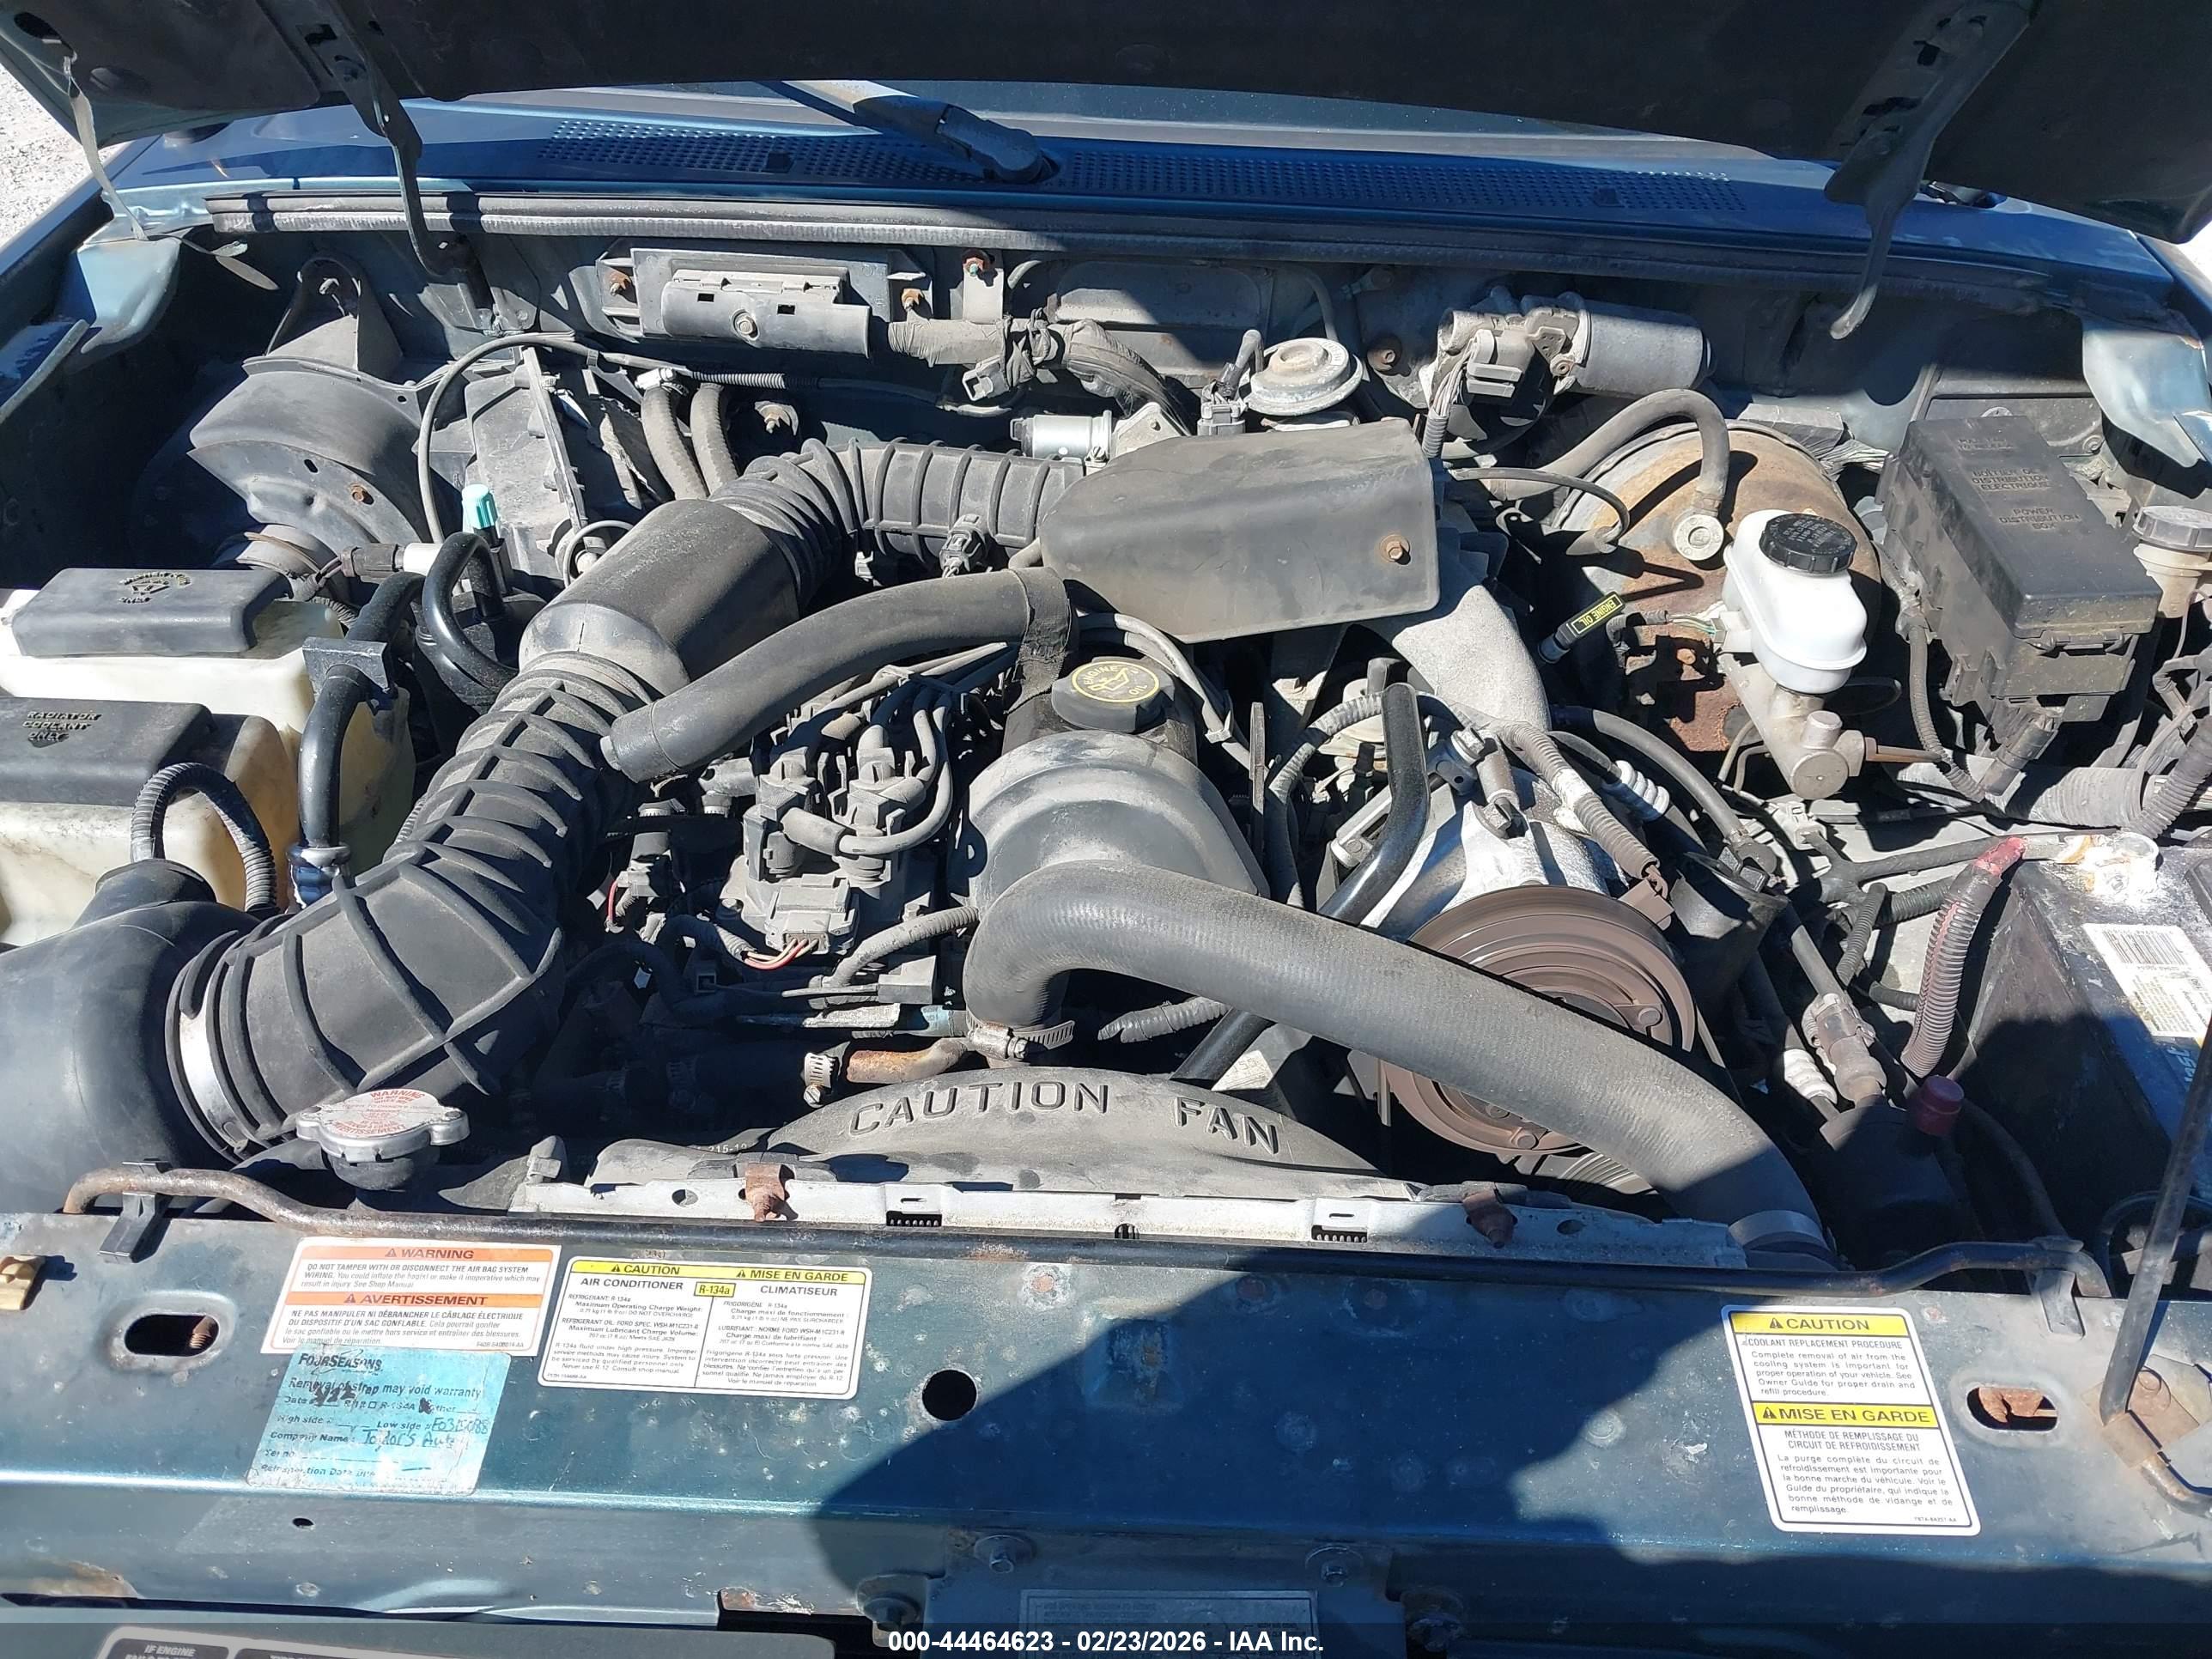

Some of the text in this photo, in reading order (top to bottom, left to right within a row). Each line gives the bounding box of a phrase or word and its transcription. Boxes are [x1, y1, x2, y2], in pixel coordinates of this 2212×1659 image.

[1972, 475, 2049, 484] DISTRIBUTION
[1998, 514, 2081, 523] DISTRIBUTION
[1578, 599, 1616, 627] ENGINE OIL
[1082, 665, 1121, 686] ENGINE
[1128, 684, 1149, 696] OIL
[27, 711, 102, 721] RADIATOR
[21, 720, 93, 731] COOLANT
[27, 731, 70, 741] ONLY
[370, 1090, 426, 1102] WARNING
[848, 1079, 1279, 1155] CAUTION FAN
[399, 1249, 475, 1259] WARNING
[623, 1264, 680, 1274] CAUTION
[750, 1270, 848, 1281] MISE EN GARDE
[580, 1278, 684, 1289] AIR CONDITIONER
[698, 1284, 731, 1294] R-134a
[759, 1285, 837, 1296] CLIMATISEUR
[360, 1294, 488, 1305] AVERTISSEMENT
[377, 1310, 429, 1318] DÉBRANCHER
[441, 1310, 477, 1319] CÂBLAGE
[1784, 1318, 1870, 1330] CAUTION
[1750, 1351, 1795, 1360] Complete
[1844, 1362, 1892, 1370] important
[380, 1385, 405, 1396] may
[408, 1383, 431, 1395] void
[432, 1384, 483, 1399] warranty
[1782, 1389, 1829, 1397] procedure.
[1778, 1408, 1930, 1422] MISE EN GARDE
[1783, 1429, 1826, 1439] MÉTHODE
[1841, 1431, 1904, 1441] REMPLISSAGE
[1787, 1440, 1921, 1450] CIRCUIT DE REFROIDISSEMENT
[1826, 1455, 1871, 1464] complète
[1869, 1467, 1919, 1475] importante
[1886, 1486, 1902, 1495] qui
[1903, 1487, 1938, 1496] indique
[1884, 1497, 1923, 1505] vidange
[143, 1644, 156, 1654] IF
[155, 1645, 197, 1657] ENGINE
